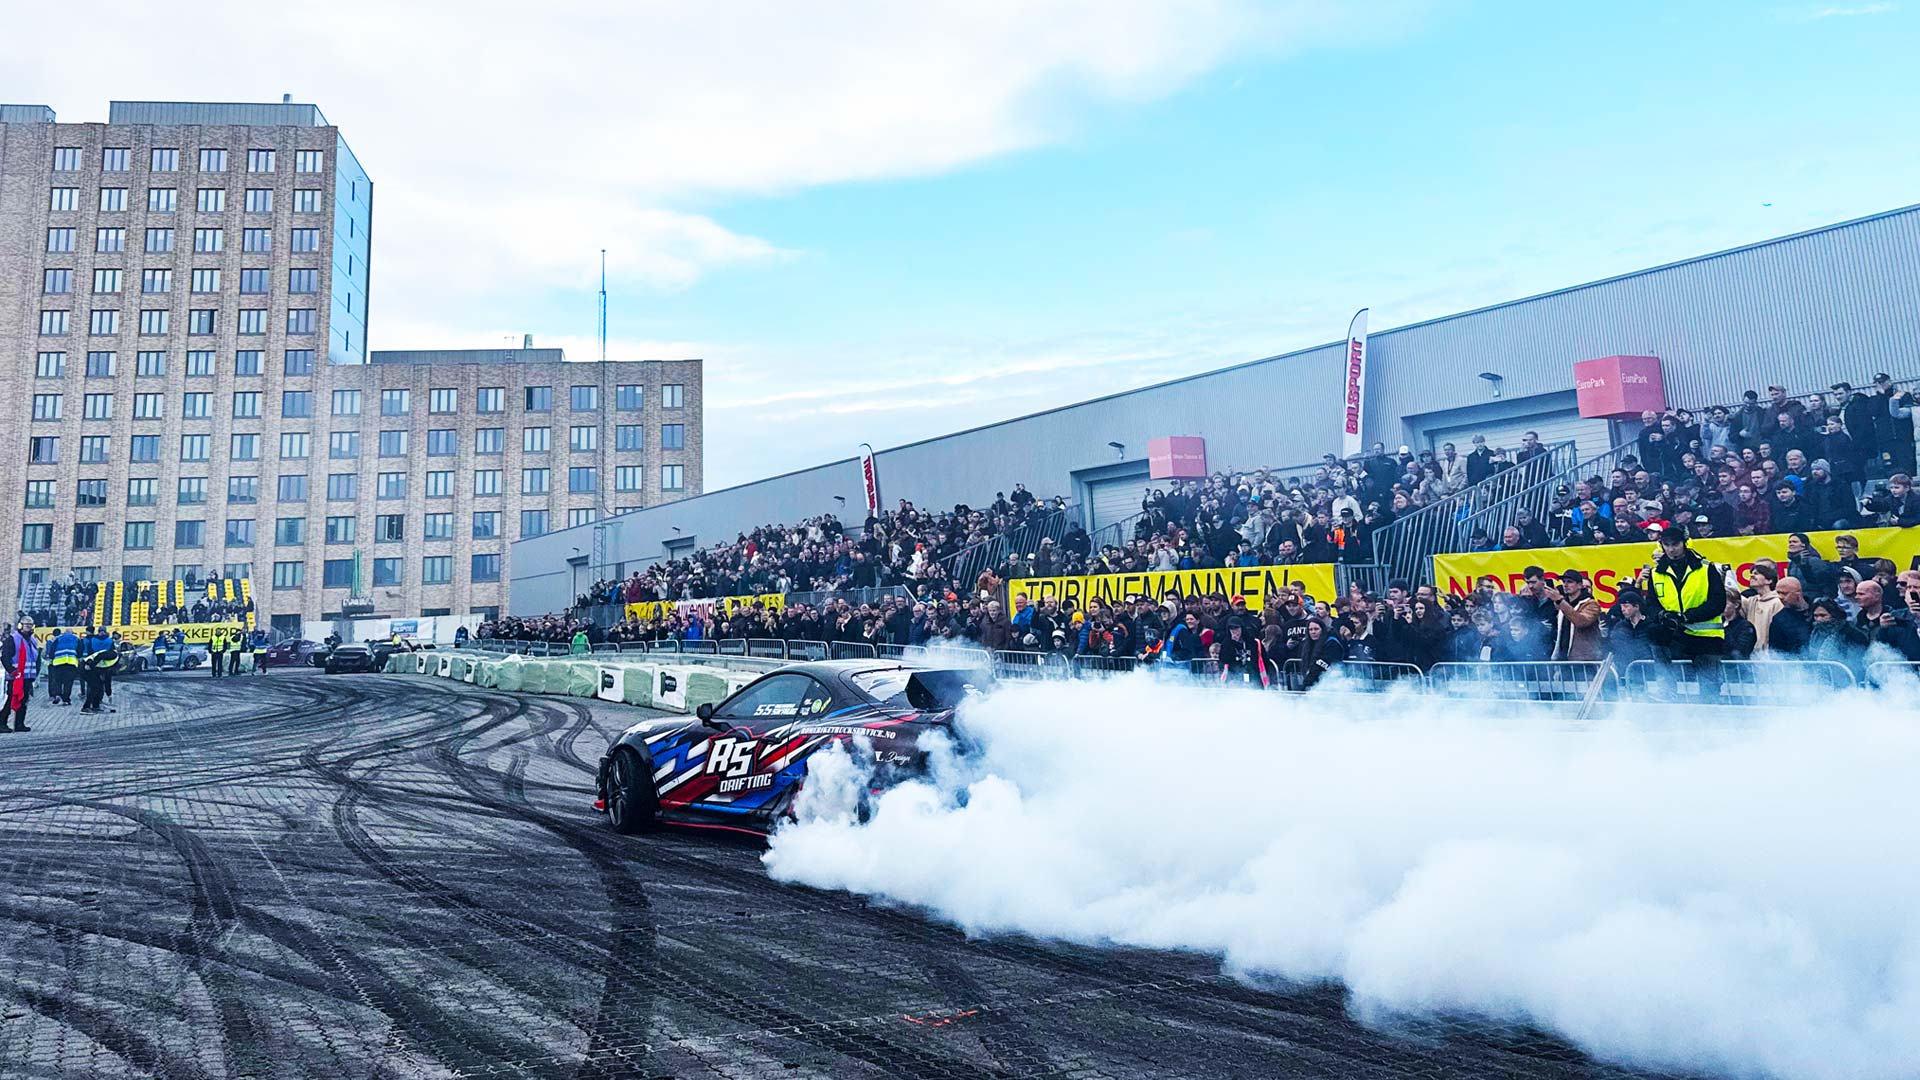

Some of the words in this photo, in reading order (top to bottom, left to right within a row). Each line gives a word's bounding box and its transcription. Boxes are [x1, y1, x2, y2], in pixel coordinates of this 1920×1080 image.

[1346, 337, 1362, 434] BILSPORT
[1621, 372, 1648, 384] EuroPark
[1025, 570, 1288, 614] TRIBUNEMANNEN
[706, 737, 758, 777] RS
[719, 773, 773, 793] DRIFTING
